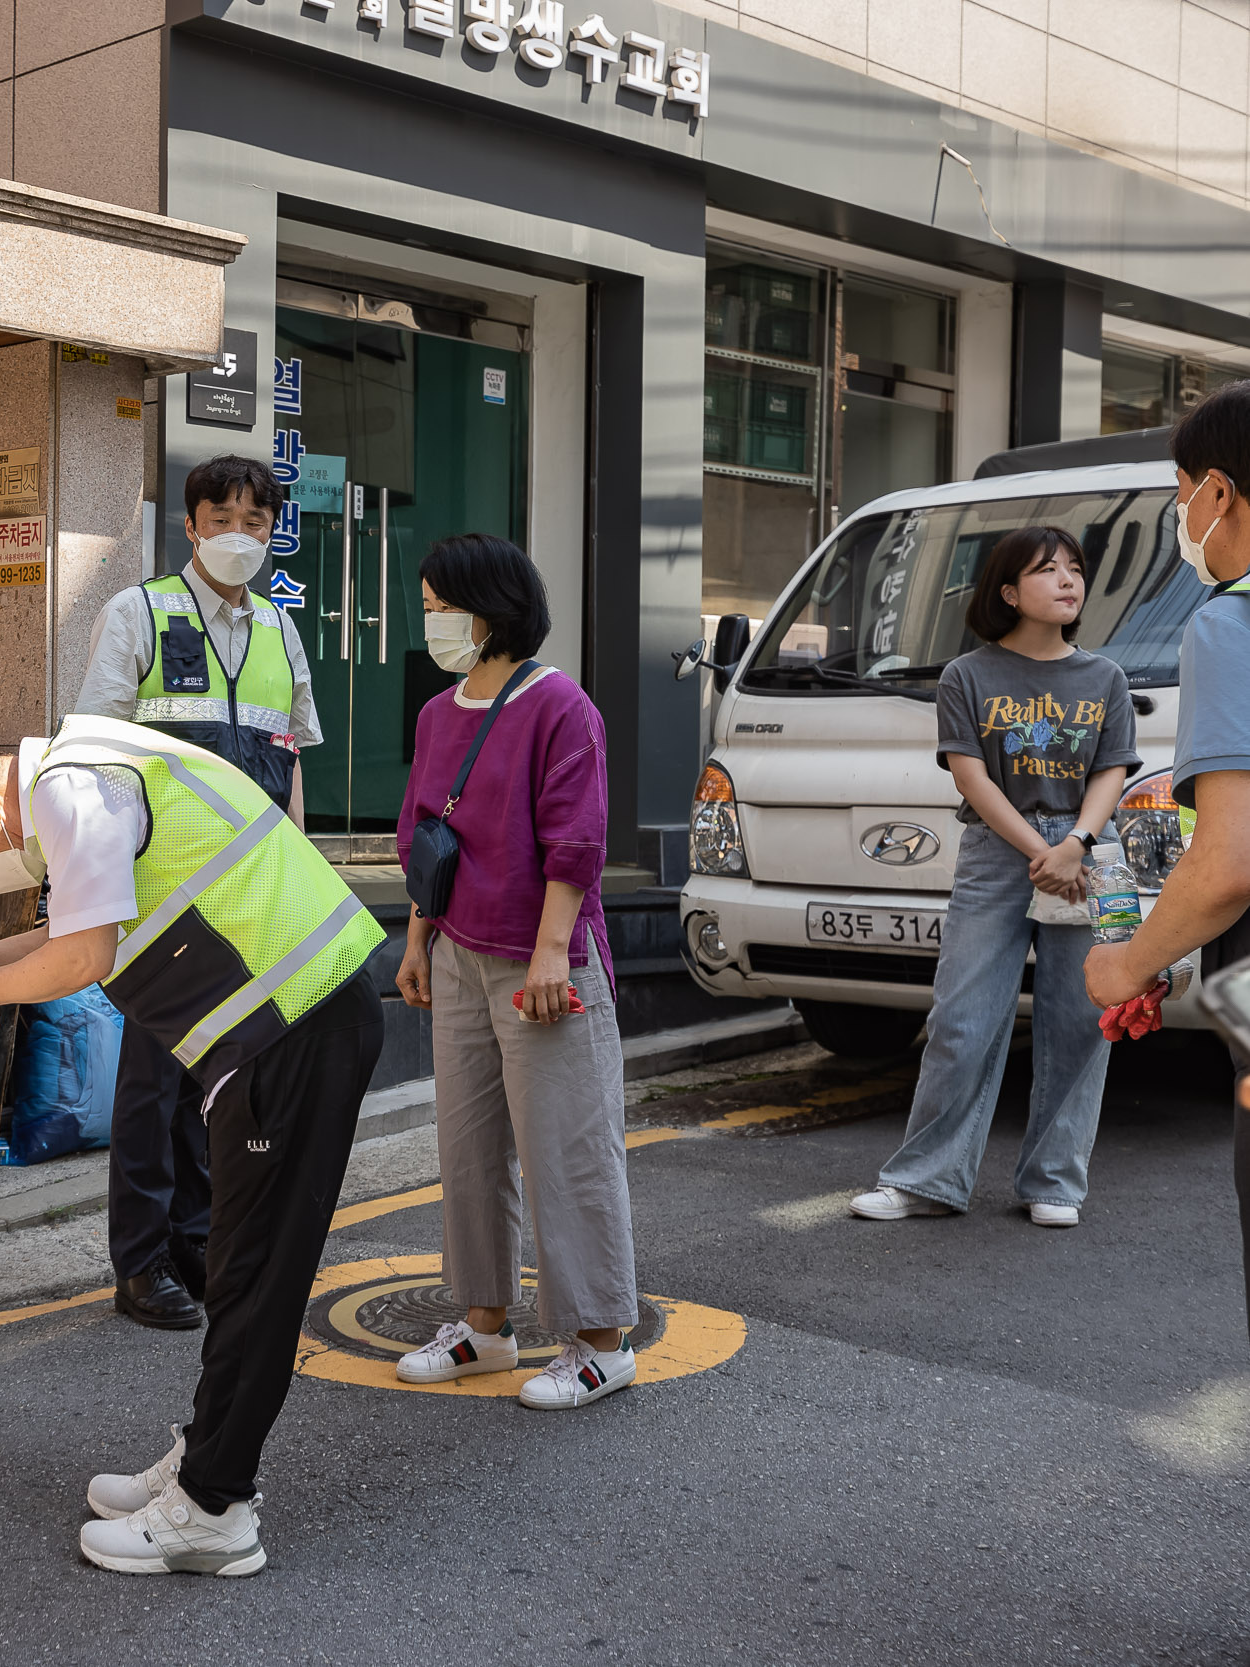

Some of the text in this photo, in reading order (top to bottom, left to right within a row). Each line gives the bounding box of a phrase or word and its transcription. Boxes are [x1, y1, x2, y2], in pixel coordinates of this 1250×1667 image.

[485, 371, 504, 383] CCTV
[979, 691, 1071, 738] Reality
[1011, 755, 1085, 779] Pause
[821, 910, 942, 946] 83두 314
[247, 1140, 271, 1149] ELLE
